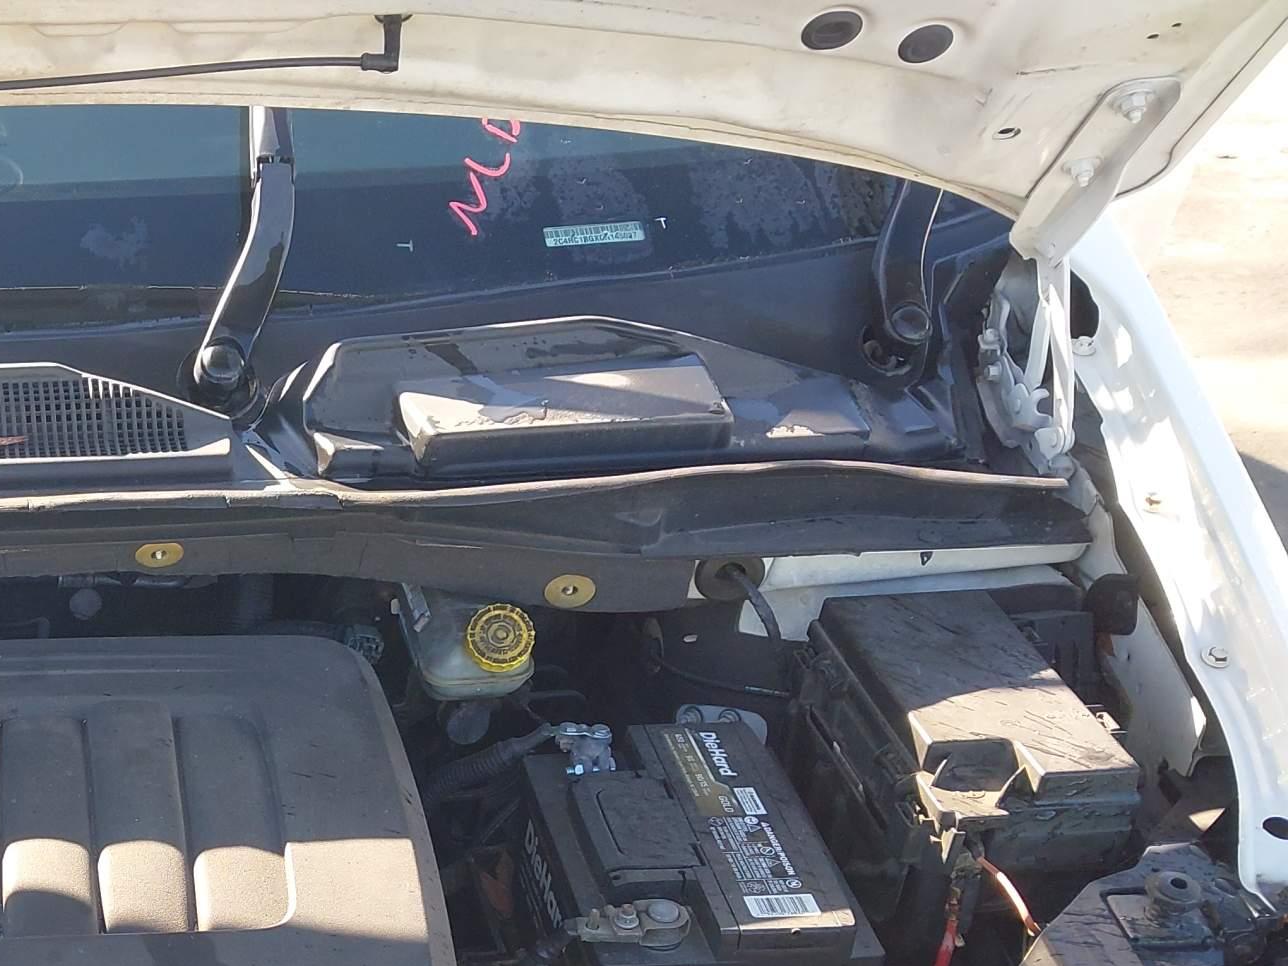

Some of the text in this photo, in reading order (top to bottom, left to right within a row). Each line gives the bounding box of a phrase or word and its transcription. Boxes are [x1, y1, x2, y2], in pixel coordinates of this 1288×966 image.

[698, 731, 738, 777] DieHard
[718, 795, 735, 813] GOLD
[525, 819, 562, 929] DieHar
